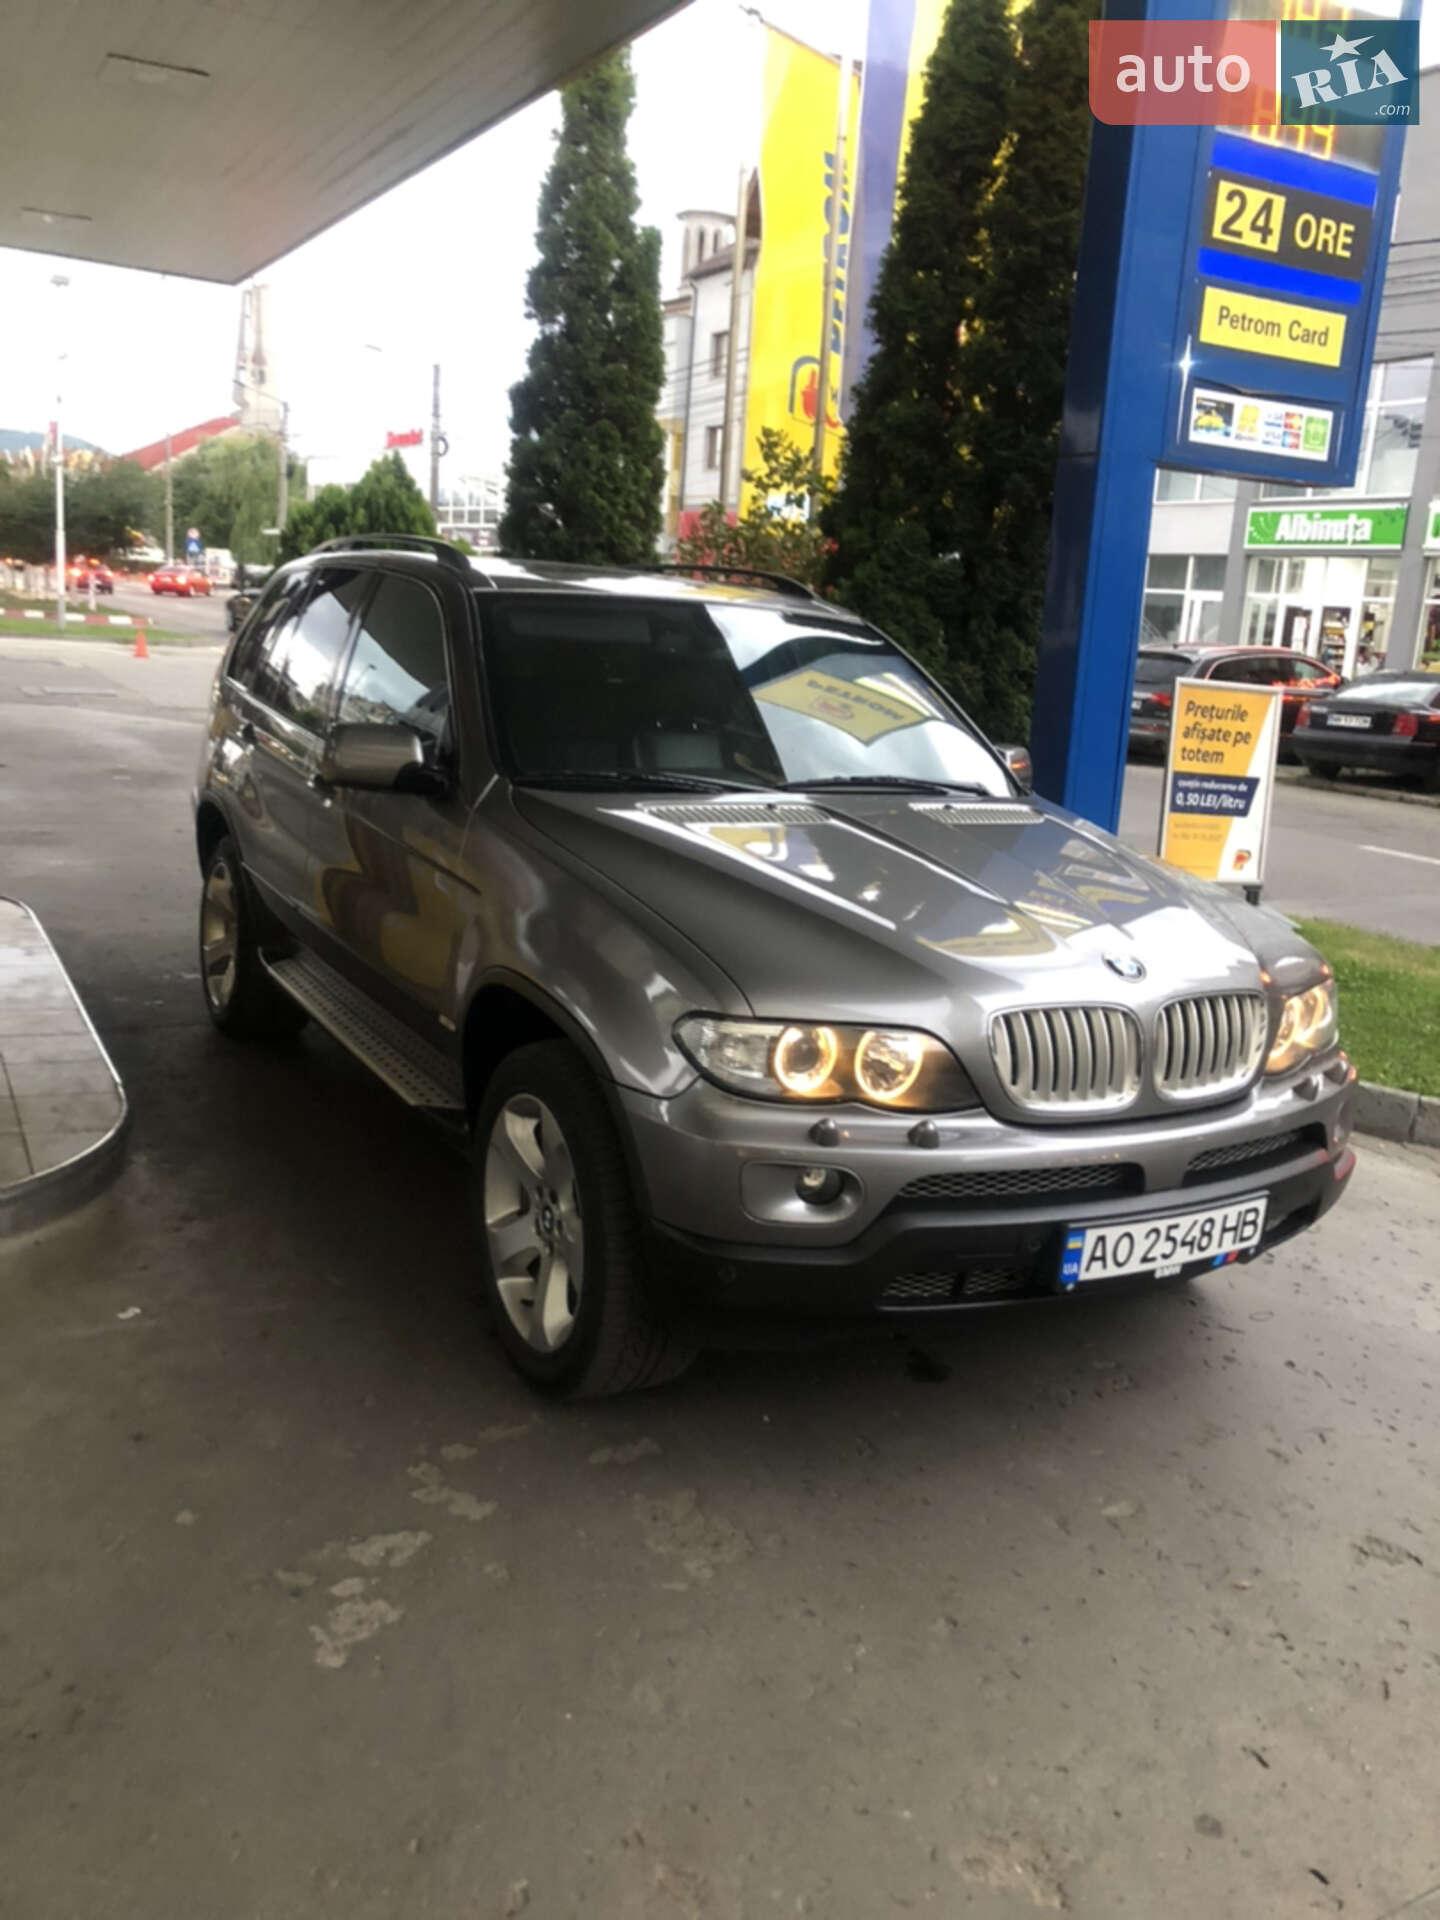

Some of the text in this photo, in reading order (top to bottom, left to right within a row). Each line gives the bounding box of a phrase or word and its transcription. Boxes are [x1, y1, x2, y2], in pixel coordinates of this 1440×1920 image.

[1220, 188, 1355, 259] 24 ORE
[1218, 305, 1329, 347] Petrom Card
[1185, 700, 1248, 723] Prețurile
[1182, 721, 1252, 748] afișate pe
[1181, 747, 1224, 763] totem
[1086, 1207, 1260, 1273] AO 2548 HB
[1063, 1263, 1079, 1275] UA
